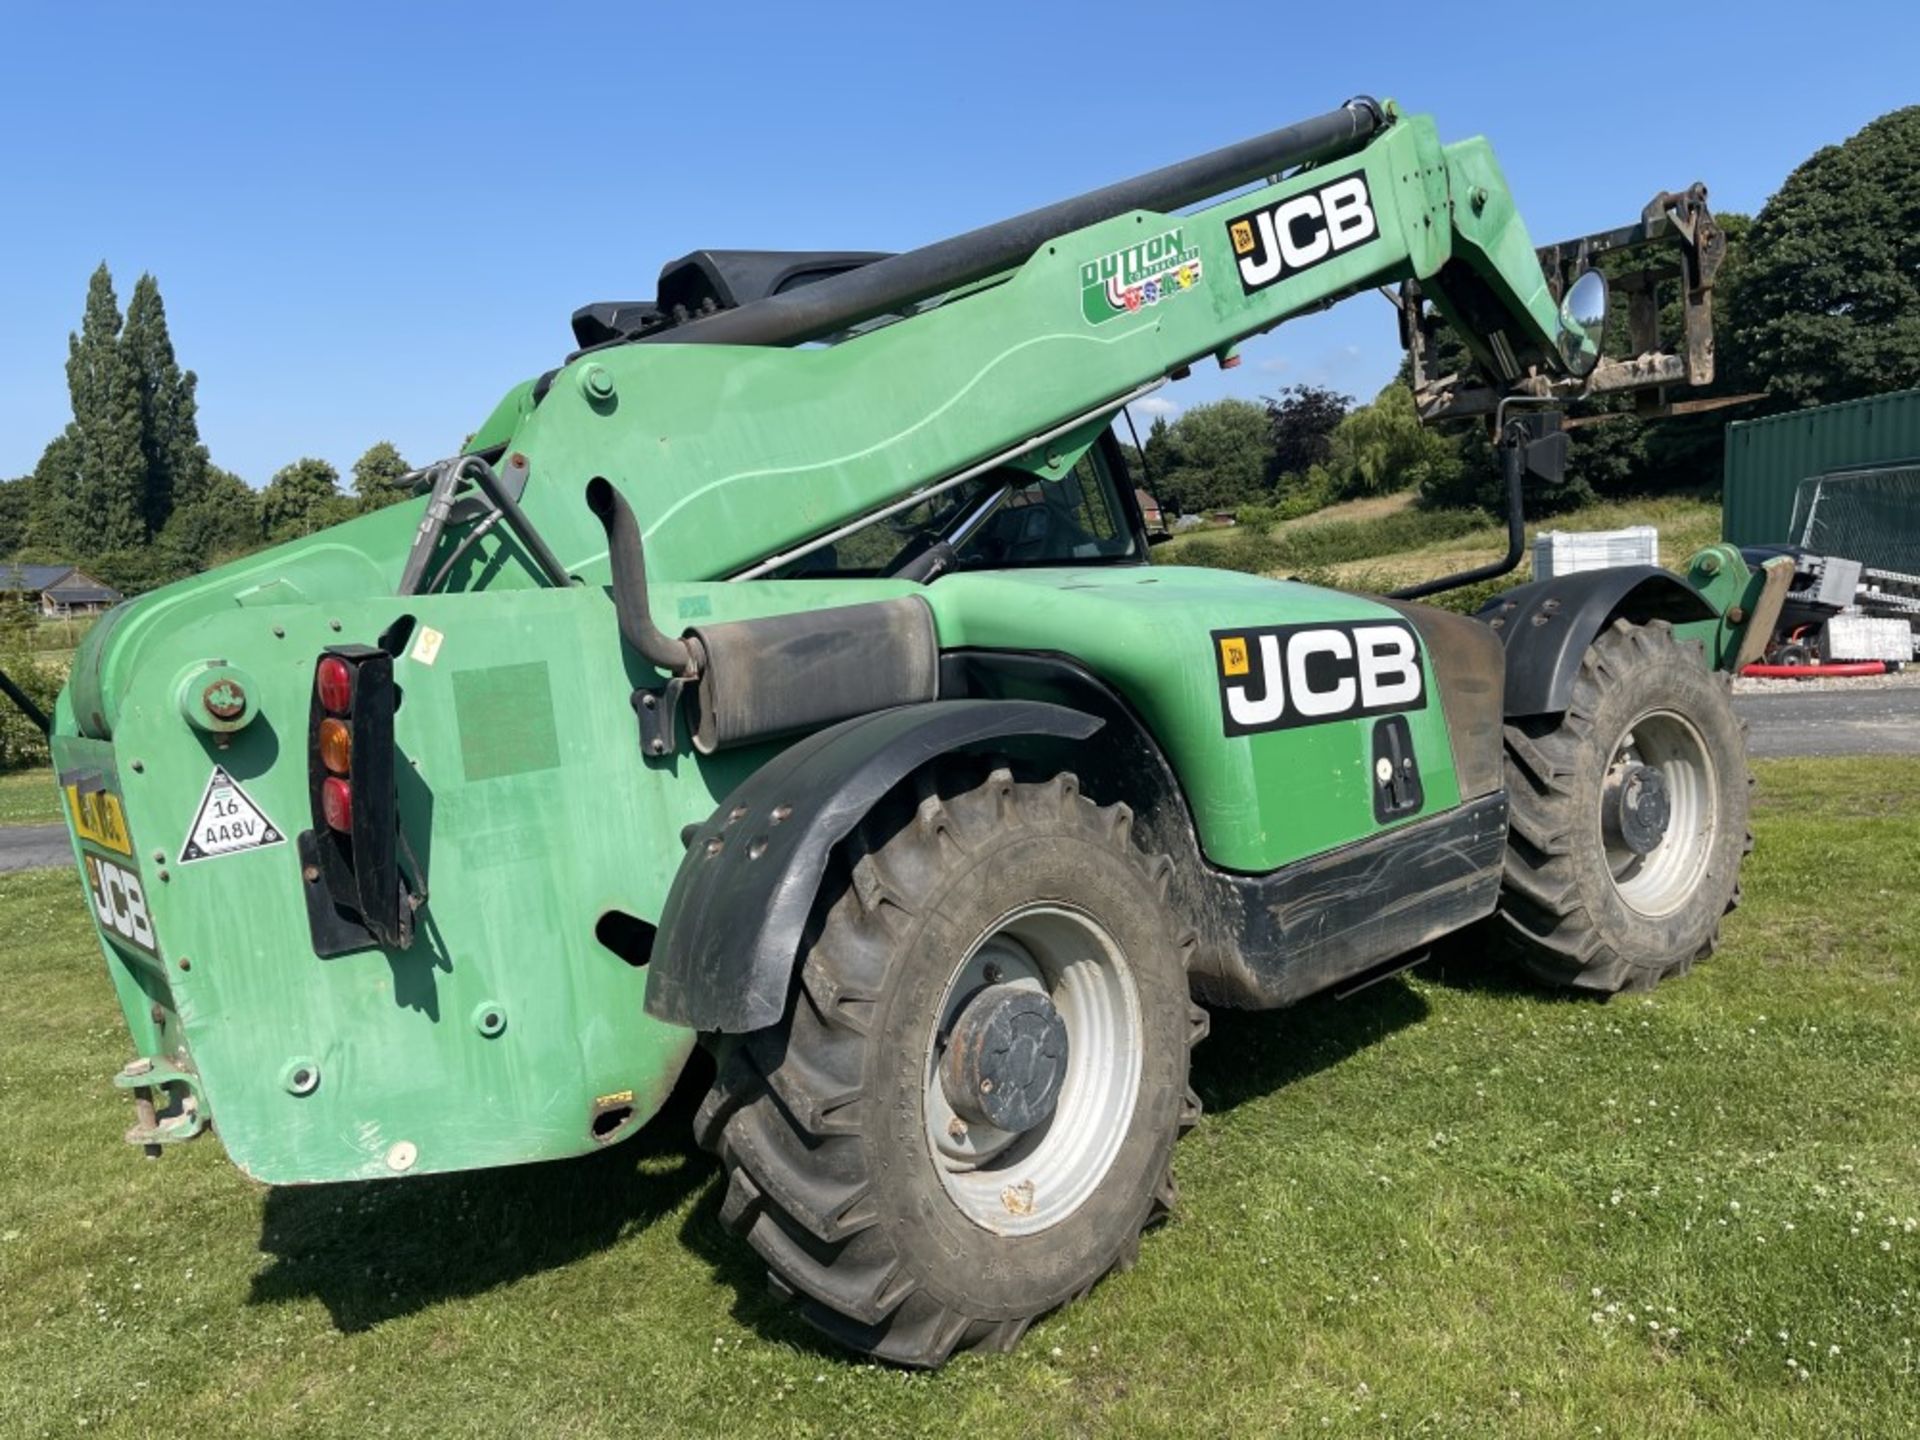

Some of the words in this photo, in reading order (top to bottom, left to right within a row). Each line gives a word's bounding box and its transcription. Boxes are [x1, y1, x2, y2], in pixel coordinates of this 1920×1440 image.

[1081, 227, 1184, 288] DUTTON
[1239, 177, 1376, 287] JCB
[1226, 625, 1422, 725] JCB
[206, 819, 256, 844] AA8V
[213, 798, 239, 818] 16
[94, 859, 155, 950] JCB
